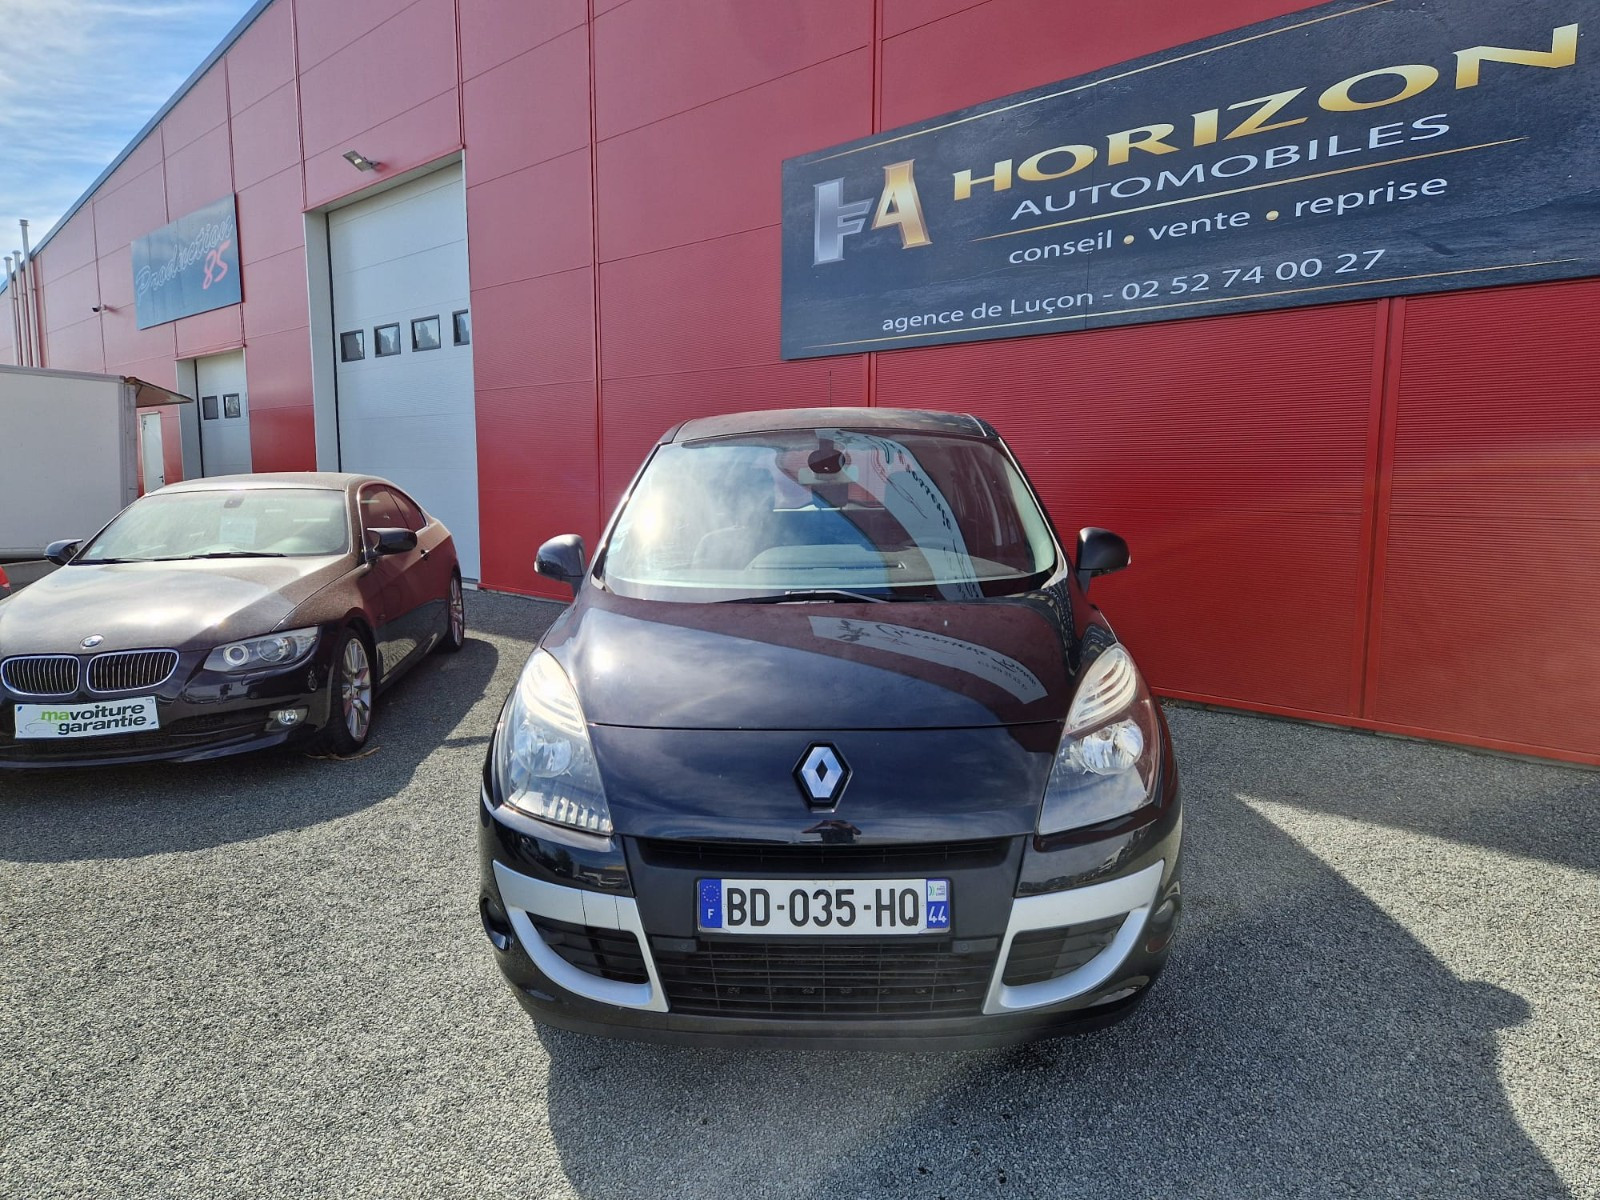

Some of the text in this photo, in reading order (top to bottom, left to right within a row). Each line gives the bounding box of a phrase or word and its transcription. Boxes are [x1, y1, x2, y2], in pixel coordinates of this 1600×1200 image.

[952, 22, 1578, 201] HORIZON
[1010, 113, 1450, 220] AUTOMOBILES
[1008, 177, 1448, 264] conseil vente reprise
[202, 239, 231, 290] 85
[882, 307, 964, 333] agence
[971, 302, 1003, 320] de
[1010, 292, 1094, 315] Luçon
[1121, 281, 1160, 301] 02
[1170, 274, 1210, 294] 52
[1221, 266, 1265, 289] 74
[1275, 258, 1322, 280] 00
[1334, 249, 1386, 274] 27
[41, 704, 145, 721] mavoiture
[57, 714, 147, 735] garantie
[707, 908, 714, 920] F
[727, 888, 920, 927] BD-035-HQ
[928, 905, 947, 923] 44
